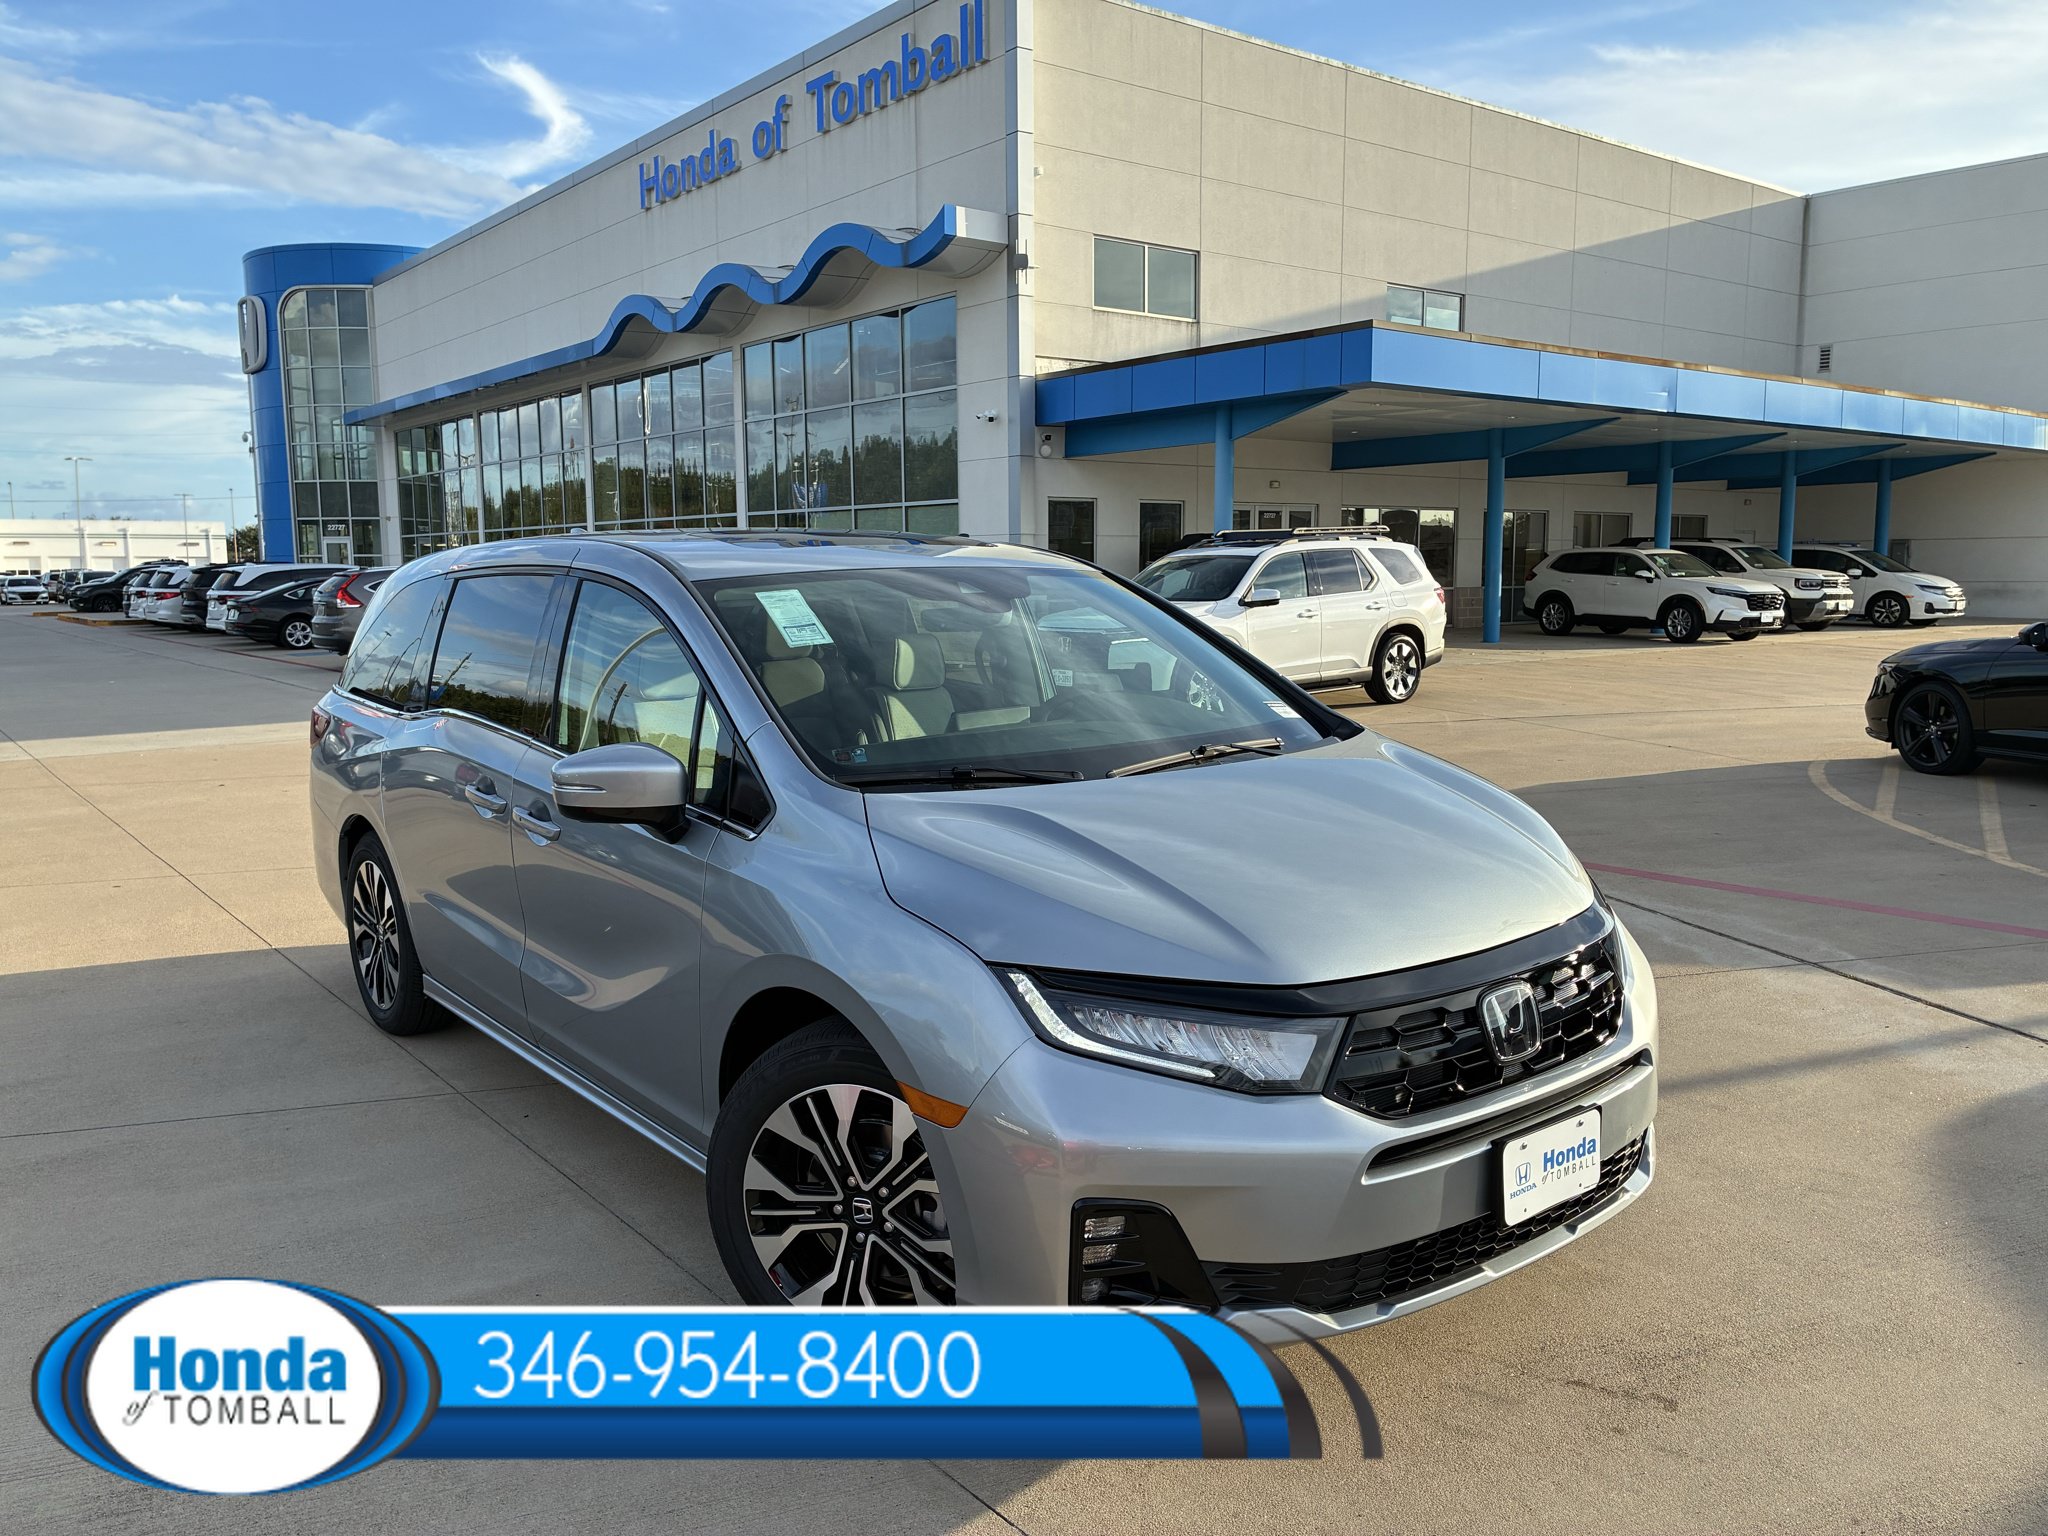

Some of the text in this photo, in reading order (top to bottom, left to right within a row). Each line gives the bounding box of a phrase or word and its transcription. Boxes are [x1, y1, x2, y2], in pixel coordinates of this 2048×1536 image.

[639, 0, 990, 210] Honda of Tomball
[1541, 1156, 1597, 1185] of TOMBALL
[1543, 1136, 1597, 1173] Honda
[1509, 1182, 1538, 1200] HONDA
